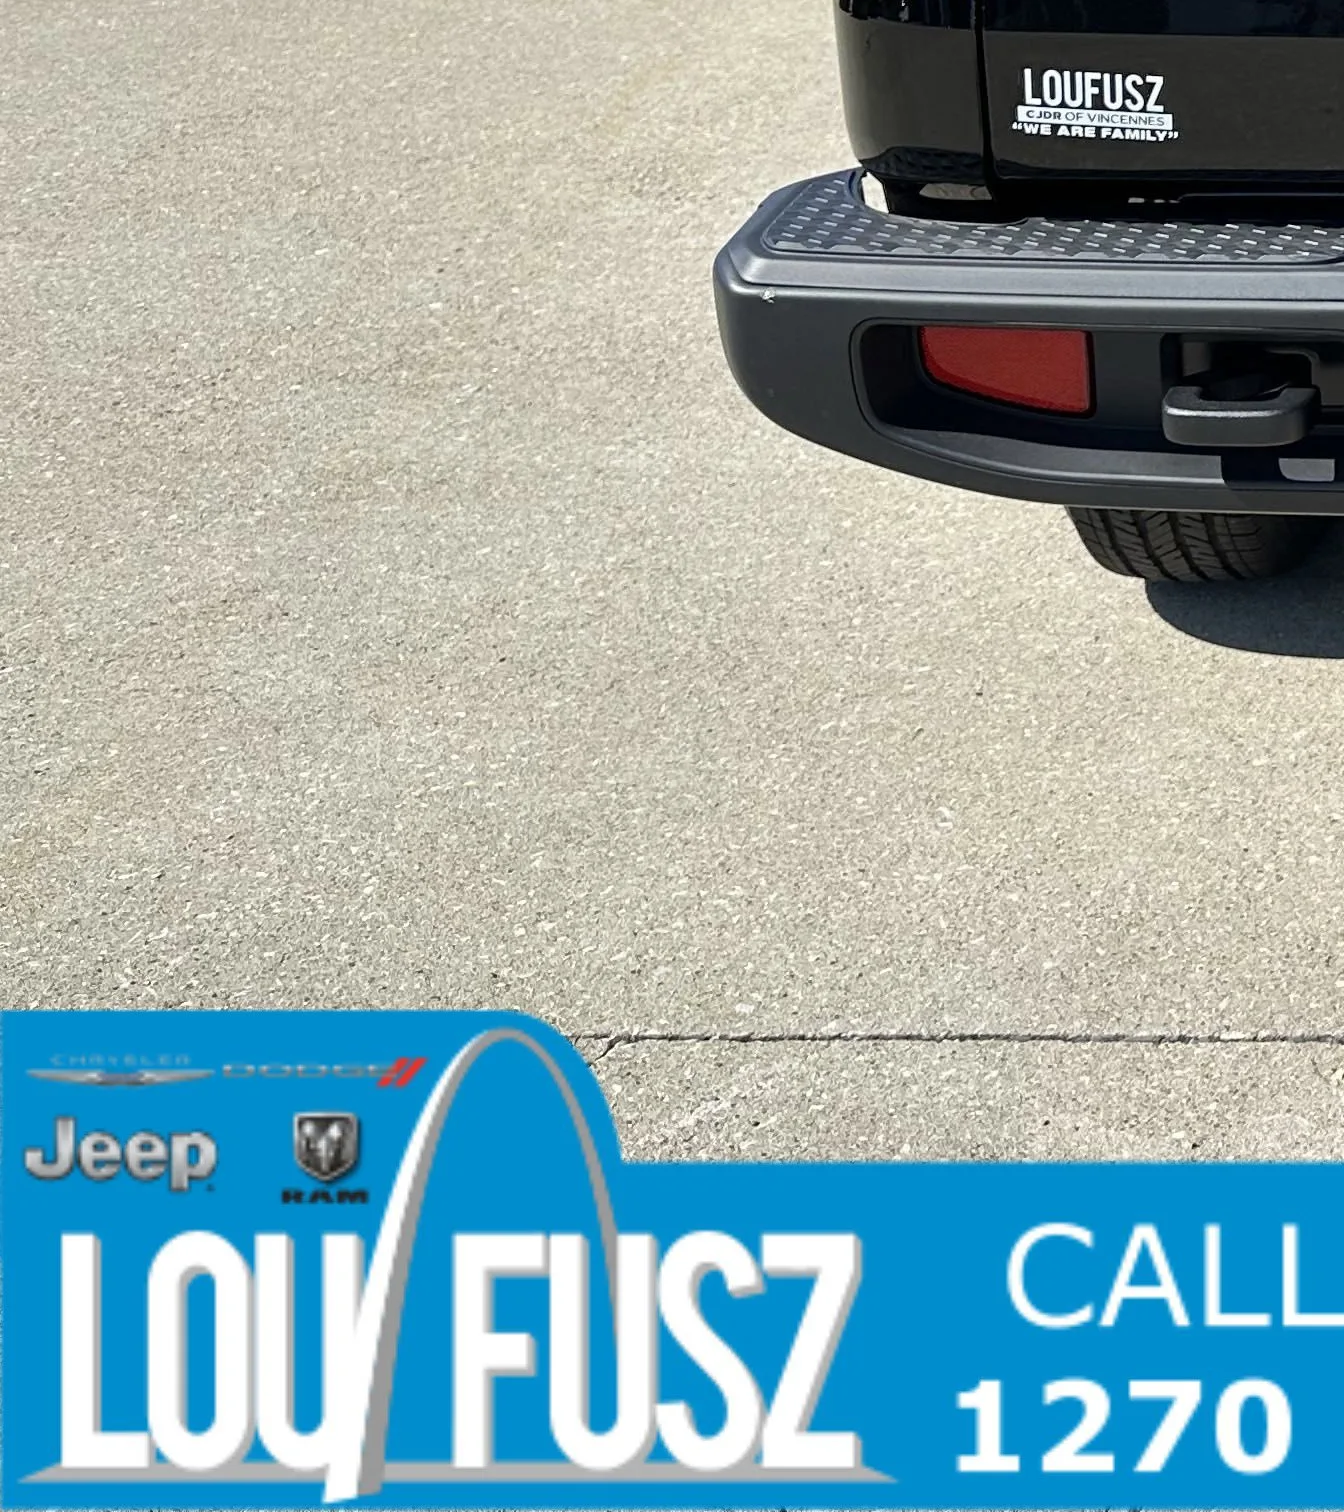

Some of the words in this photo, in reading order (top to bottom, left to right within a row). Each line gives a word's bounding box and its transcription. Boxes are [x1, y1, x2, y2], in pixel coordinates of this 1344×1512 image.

[1026, 109, 1062, 121] CJDR
[1065, 111, 1084, 122] OF
[1087, 112, 1165, 127] VINCENNES
[1056, 125, 1097, 138] ARE
